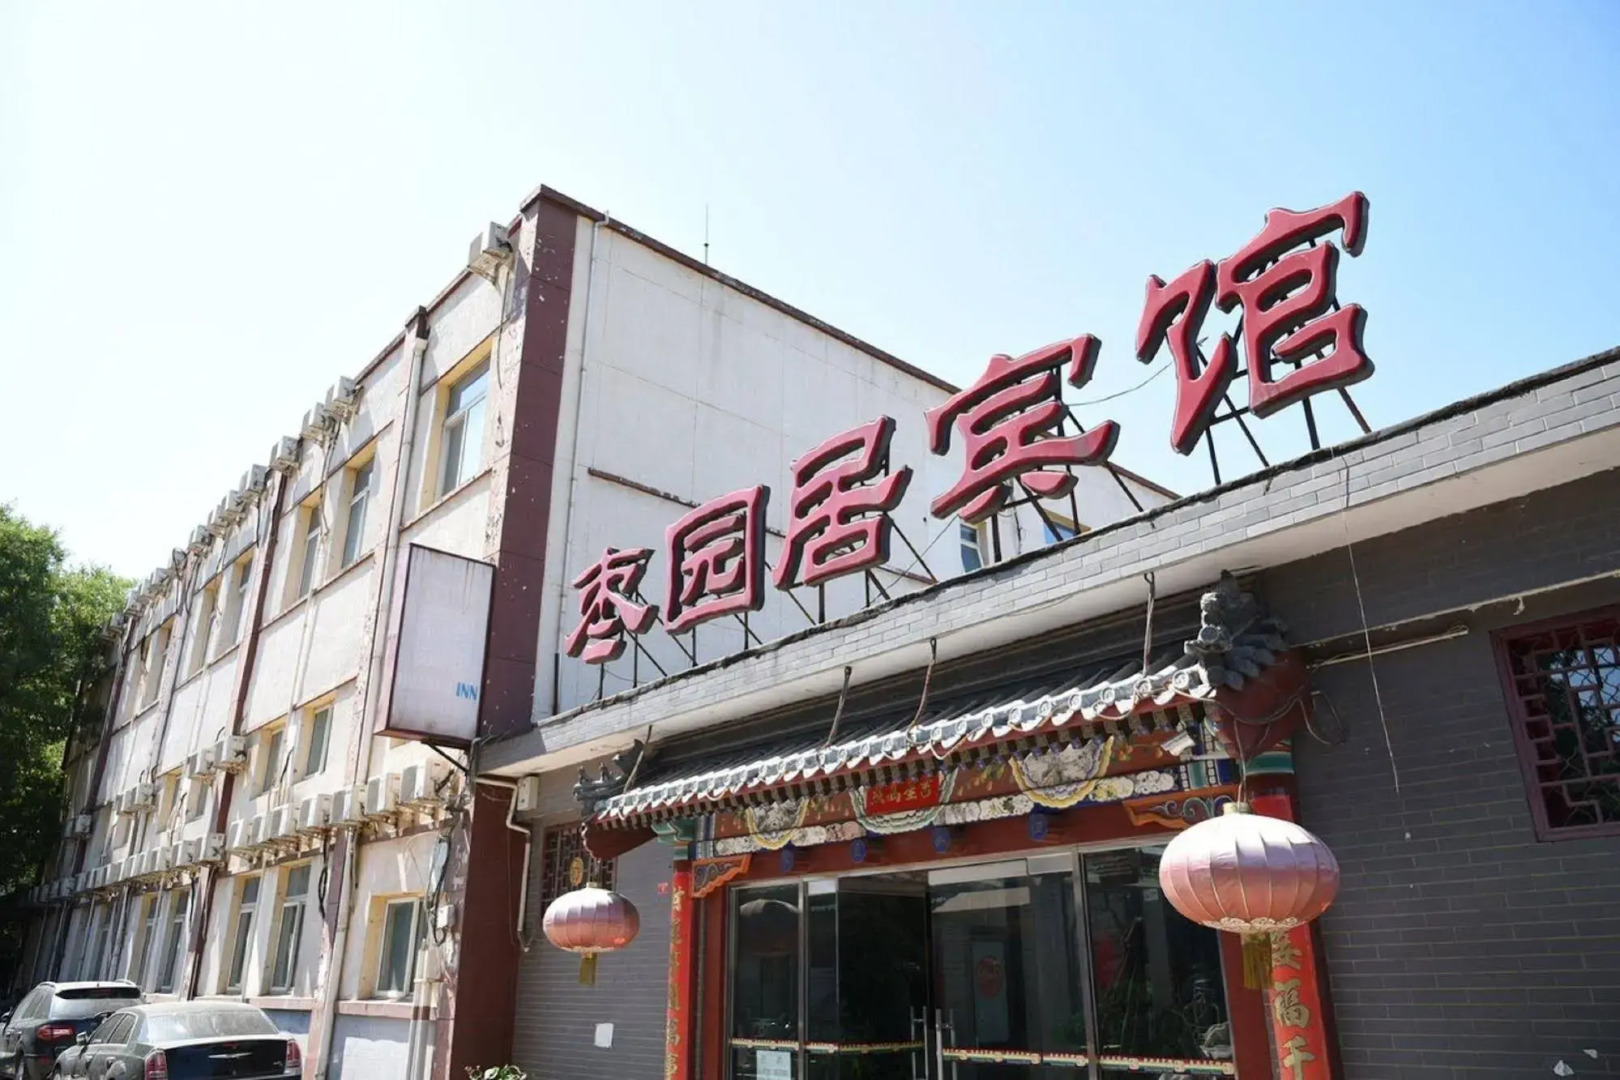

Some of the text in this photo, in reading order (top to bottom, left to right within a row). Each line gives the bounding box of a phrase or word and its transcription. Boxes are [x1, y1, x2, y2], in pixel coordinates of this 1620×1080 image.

[563, 190, 1374, 664] 枣园居宾馆
[456, 682, 478, 701] INN
